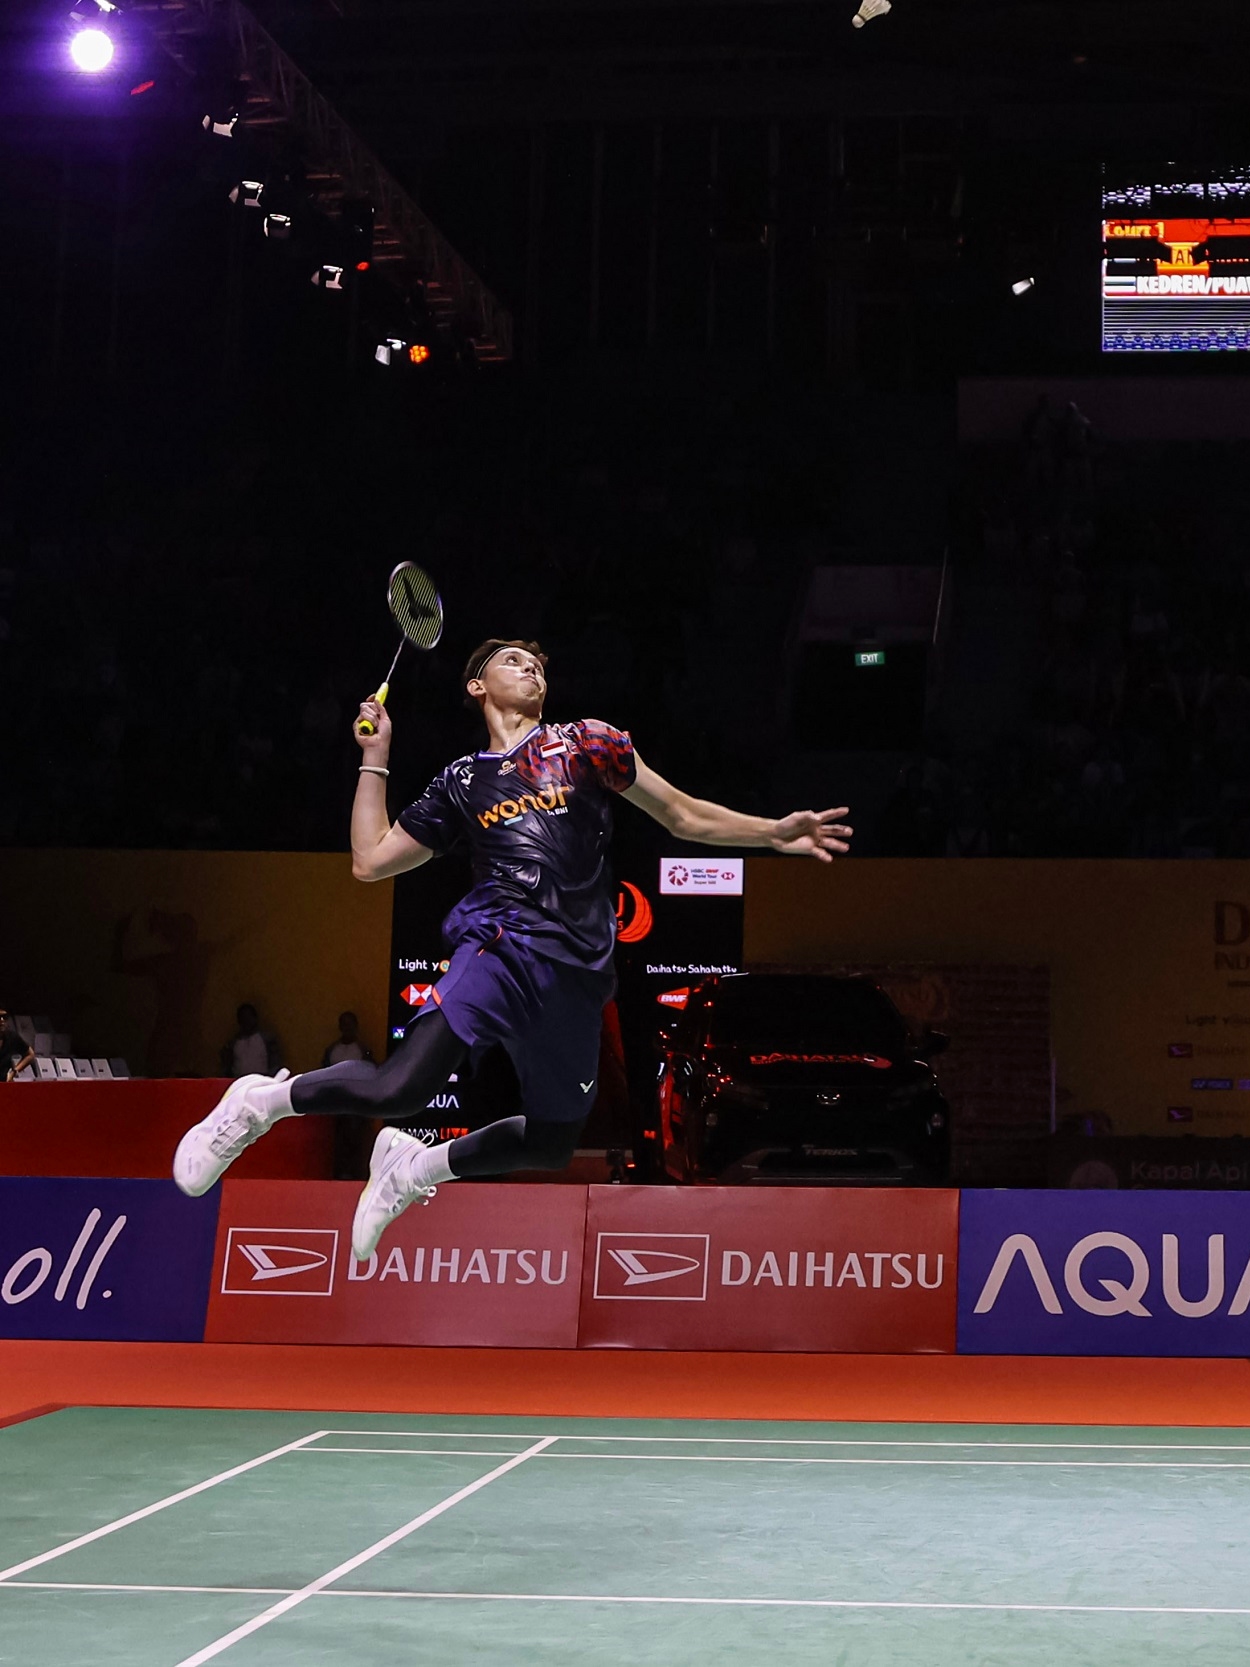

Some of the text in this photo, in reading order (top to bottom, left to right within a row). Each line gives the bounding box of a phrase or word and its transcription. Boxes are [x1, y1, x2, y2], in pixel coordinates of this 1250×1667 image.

[861, 653, 879, 664] EXIT
[476, 783, 570, 829] wondr
[398, 958, 428, 972] Light
[646, 964, 688, 974] Daihatsu
[660, 994, 688, 1003] BWF
[348, 1246, 569, 1286] DAIHATSU
[721, 1250, 946, 1291] DAIHATSU
